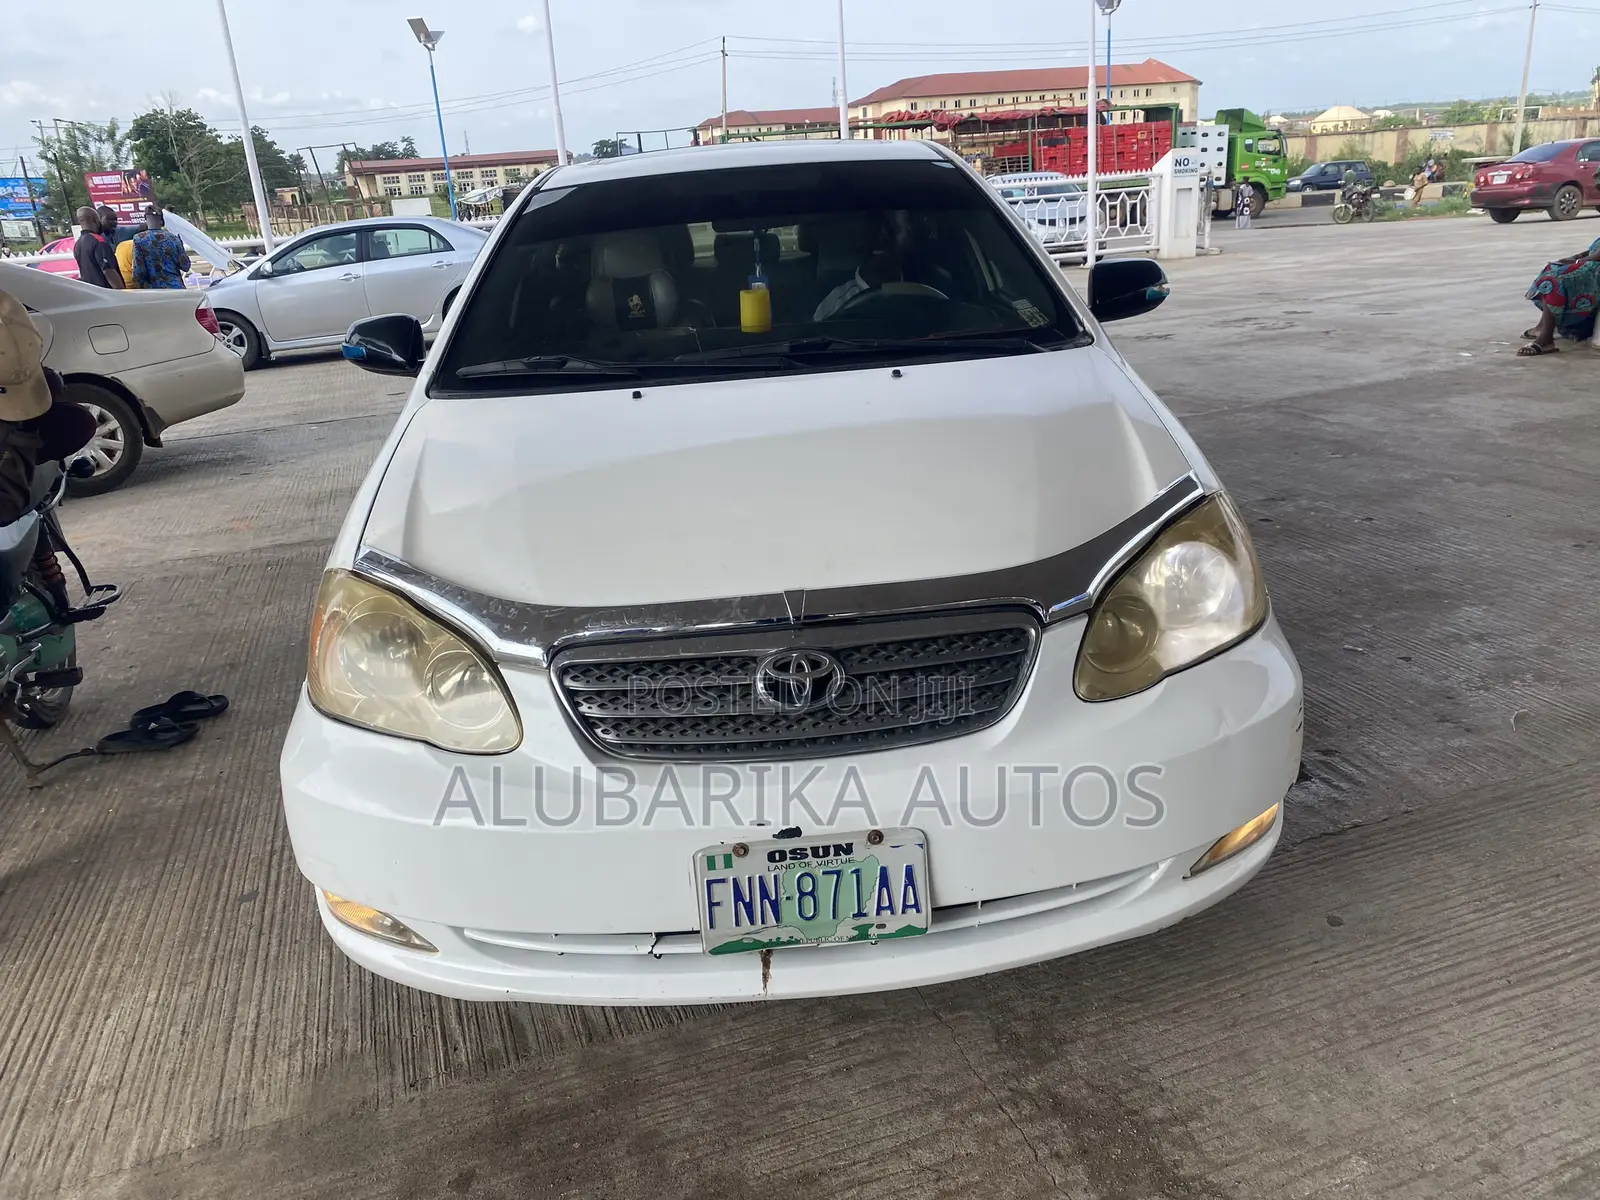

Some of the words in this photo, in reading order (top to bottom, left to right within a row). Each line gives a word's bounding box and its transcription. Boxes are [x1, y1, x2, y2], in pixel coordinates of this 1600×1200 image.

[1174, 157, 1190, 167] NO
[766, 842, 854, 863] OSUN
[767, 862, 796, 872] LAND
[798, 860, 813, 868] OF
[816, 856, 856, 867] VIRTUE
